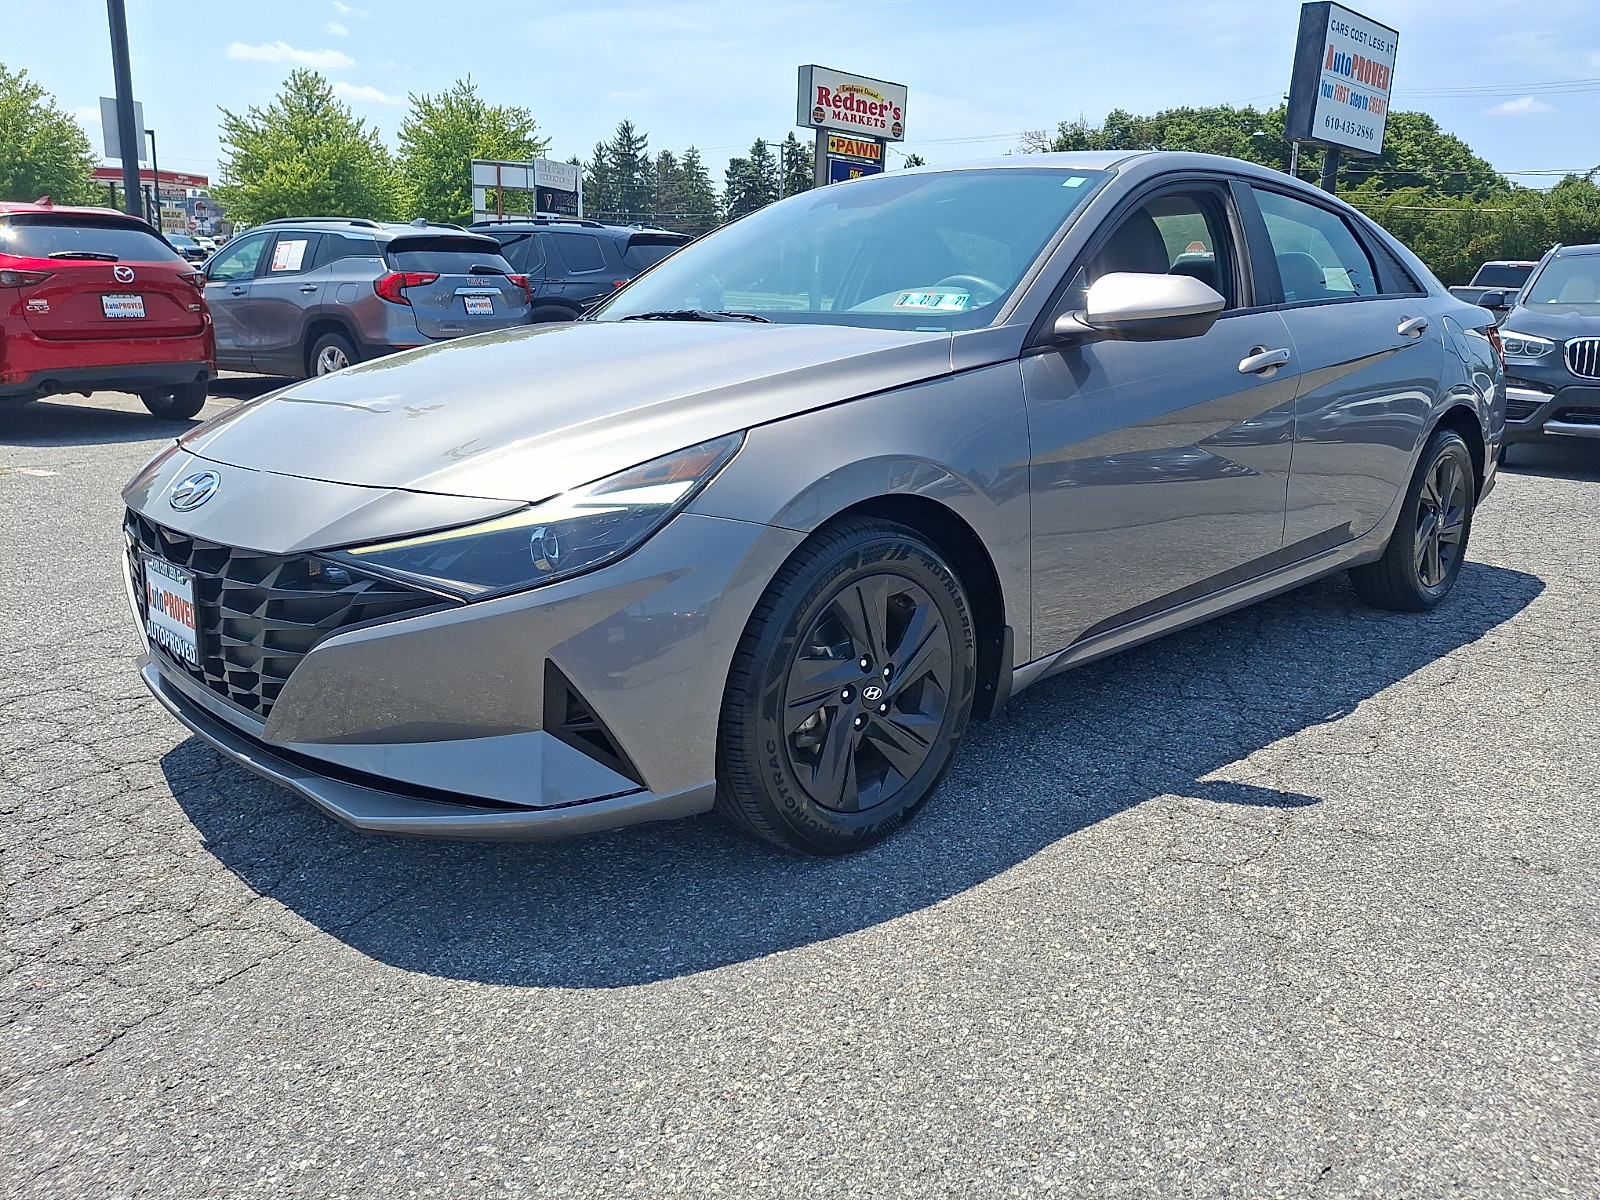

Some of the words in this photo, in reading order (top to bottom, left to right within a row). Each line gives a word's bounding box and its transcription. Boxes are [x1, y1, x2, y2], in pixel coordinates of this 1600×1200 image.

[1331, 20, 1350, 37] CARS
[1350, 28, 1367, 45] COST
[1369, 35, 1385, 52] LESS
[1386, 43, 1394, 56] AT
[1325, 44, 1390, 90] AutoPROVED
[817, 86, 901, 120] Redner's
[1321, 79, 1334, 99] Your
[1334, 84, 1350, 104] FIRST
[832, 110, 886, 129] MARKETS
[836, 139, 879, 158] PAWN
[105, 302, 142, 310] AutoPROVED
[147, 620, 196, 663] AUTOPROVED
